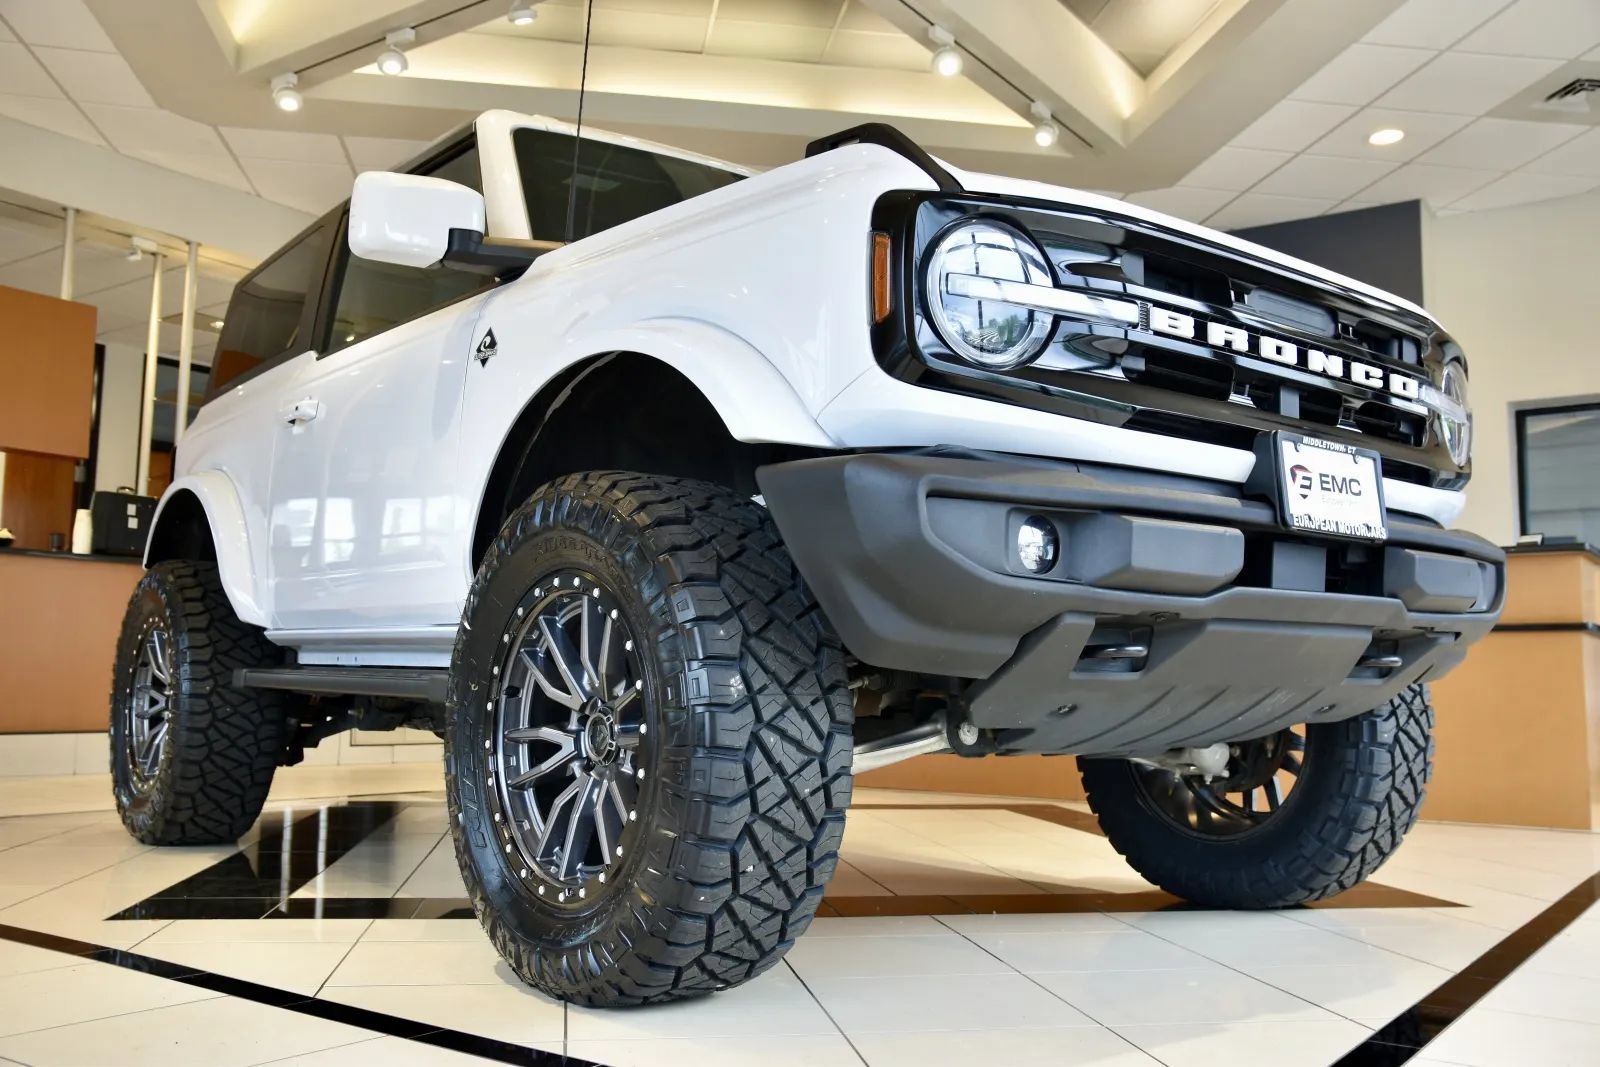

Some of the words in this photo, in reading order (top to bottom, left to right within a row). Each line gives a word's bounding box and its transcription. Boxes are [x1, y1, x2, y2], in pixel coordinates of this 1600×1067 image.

[1150, 306, 1419, 399] BRONCO
[1347, 446, 1357, 454] CT
[1319, 472, 1361, 496] EMC
